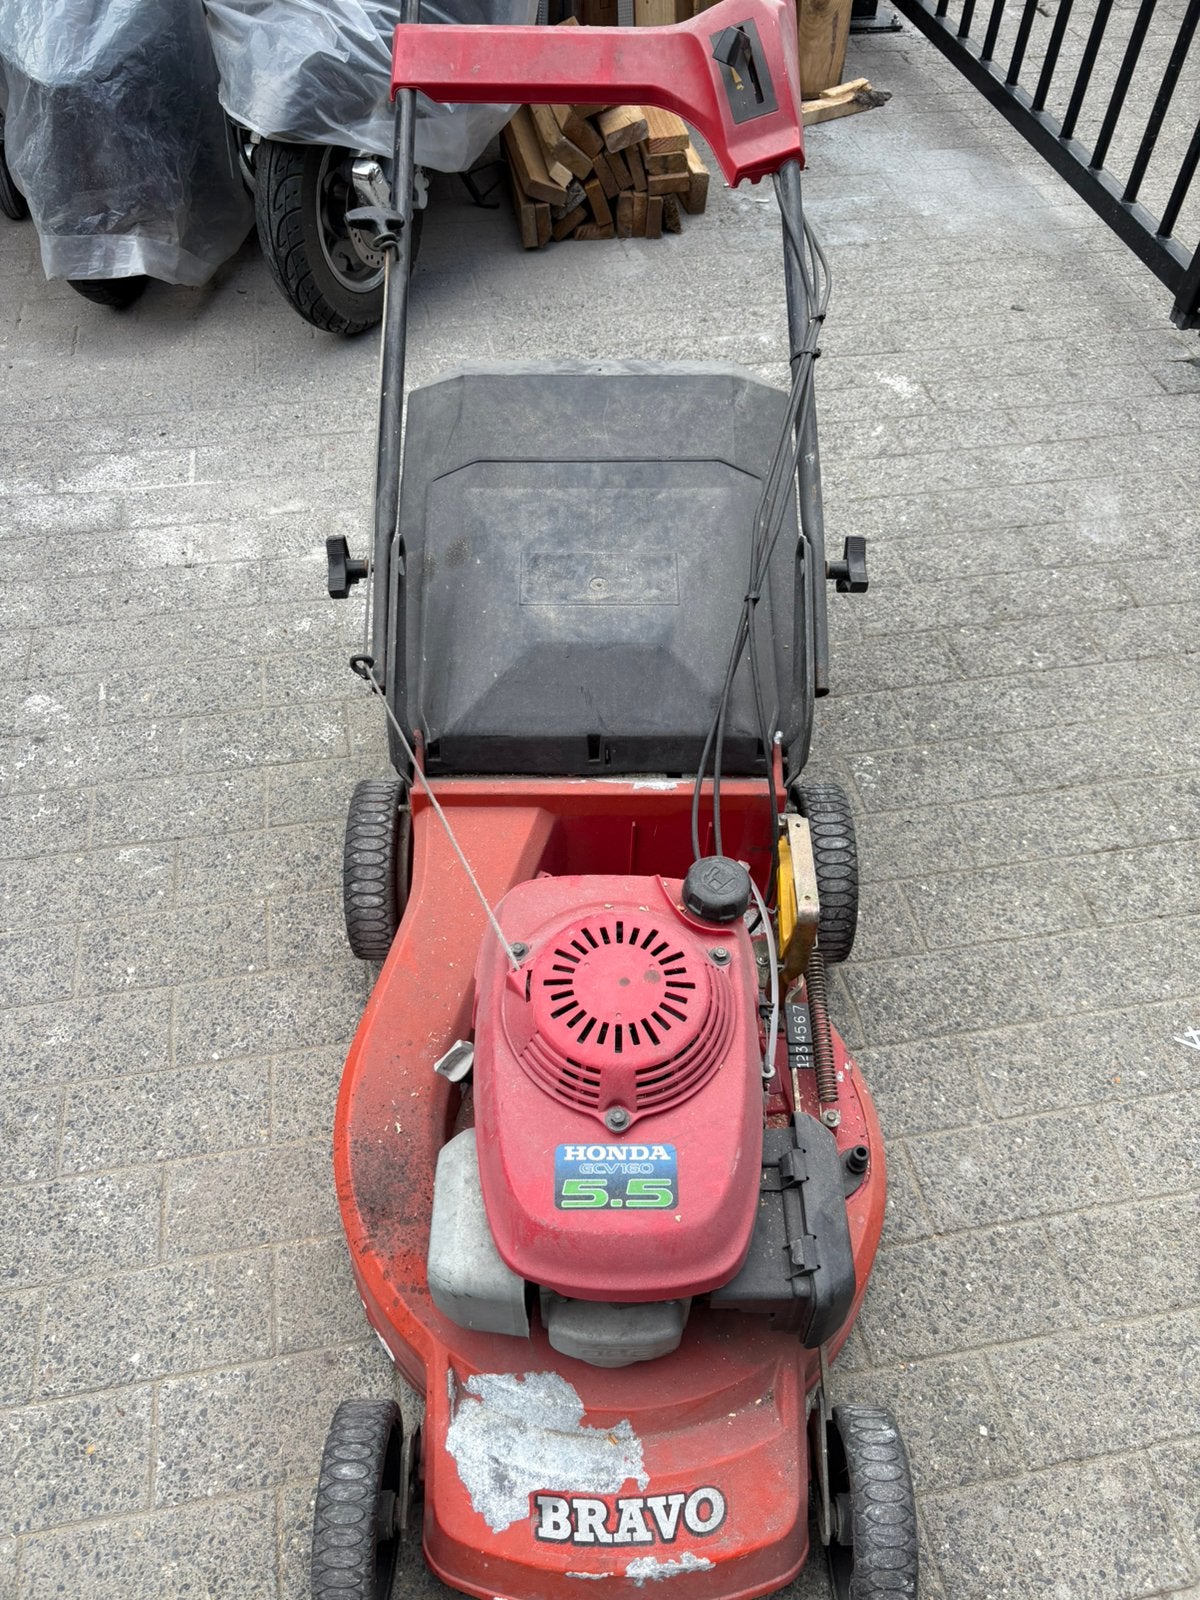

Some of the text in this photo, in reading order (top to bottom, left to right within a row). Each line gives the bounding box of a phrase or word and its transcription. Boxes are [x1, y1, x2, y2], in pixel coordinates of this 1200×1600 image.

[564, 1145, 671, 1161] HONDA
[579, 1162, 654, 1174] GCV160
[561, 1179, 673, 1208] 5.5
[536, 1486, 726, 1545] BRAVO
